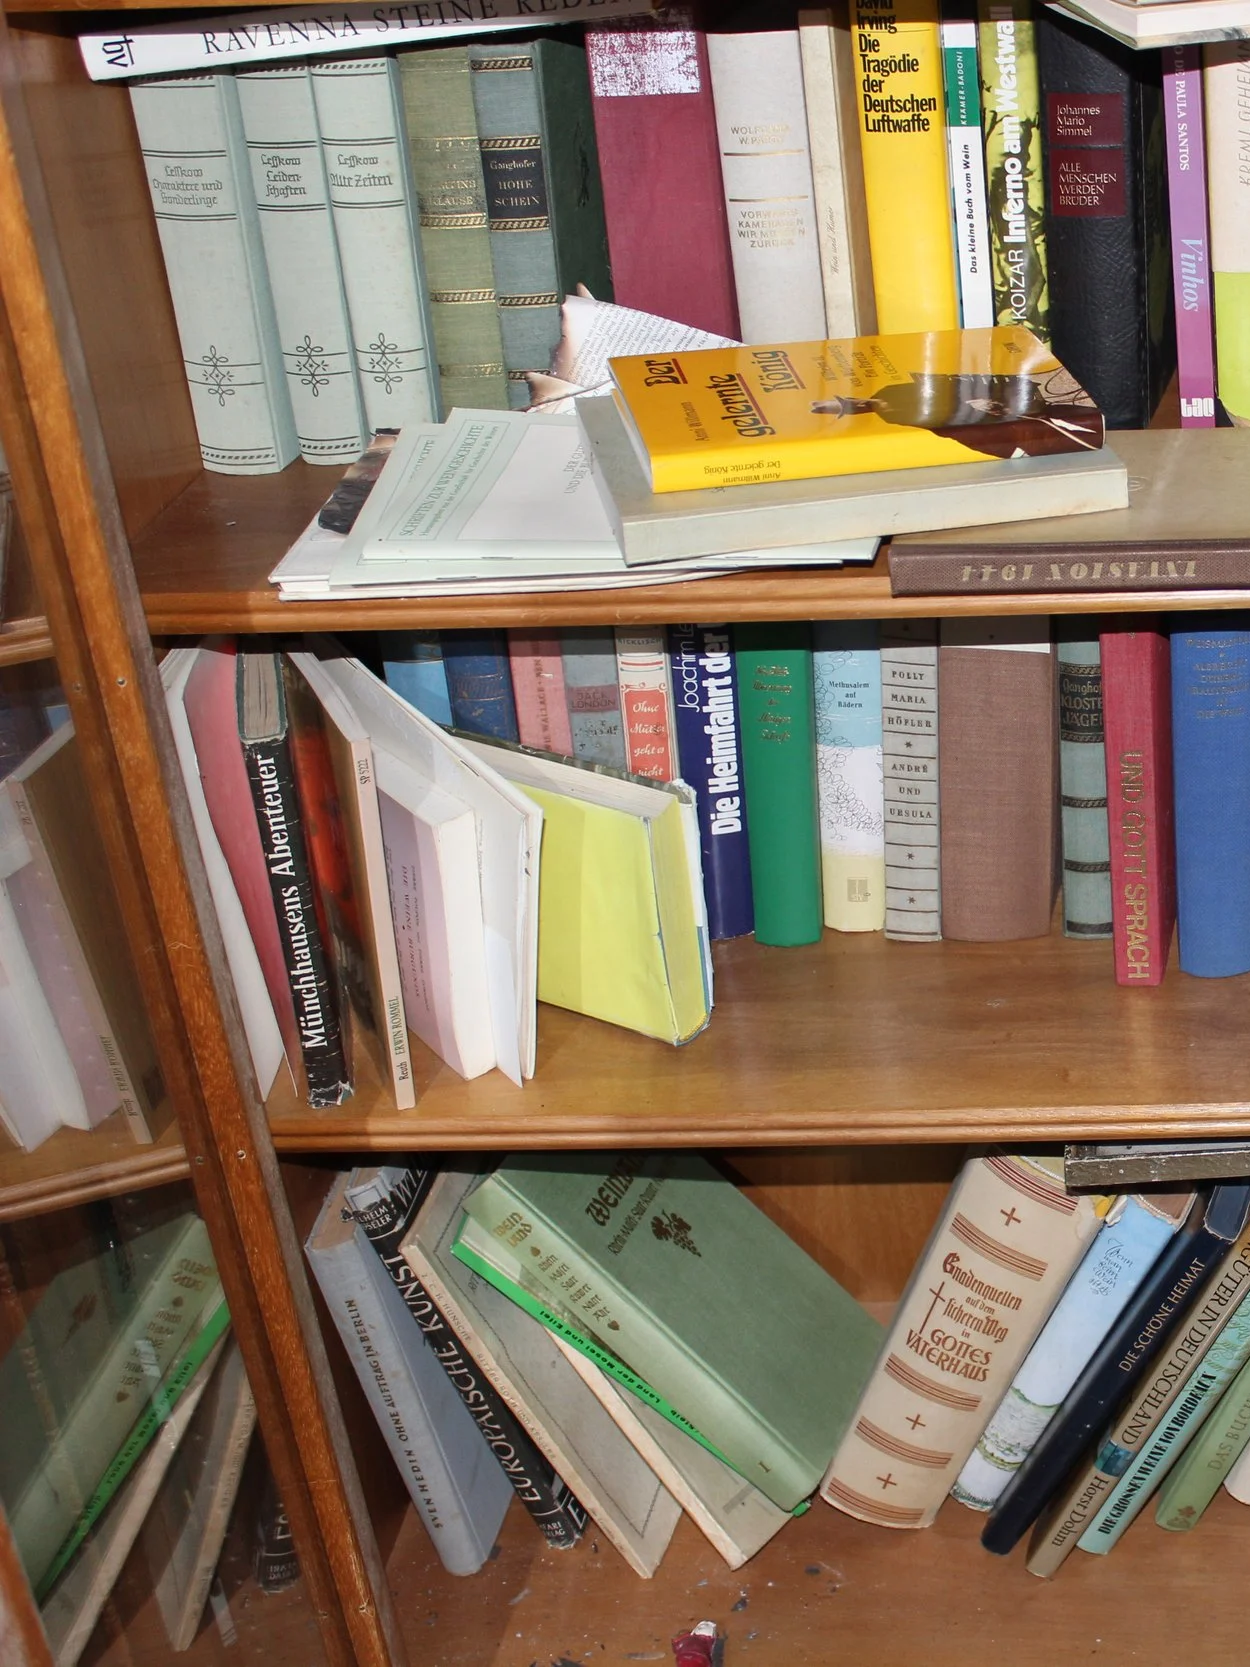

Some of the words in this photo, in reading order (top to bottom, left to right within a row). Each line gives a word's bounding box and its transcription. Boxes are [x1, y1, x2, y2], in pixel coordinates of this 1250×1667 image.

[857, 12, 897, 33] Irving
[859, 33, 880, 53] Die
[860, 54, 919, 77] Tragödie
[862, 76, 883, 93] der
[863, 94, 937, 113] Deutschen
[1056, 104, 1101, 117] Johannes
[864, 113, 930, 133] Luftwaffe
[1002, 115, 1021, 154] am
[1056, 116, 1085, 127] Mario
[1056, 126, 1092, 137] Simmel
[962, 144, 971, 169] Wein
[1059, 163, 1081, 173] ALLE
[964, 172, 973, 192] vom
[1059, 173, 1117, 184] MENSCHEN
[1059, 184, 1105, 195] WERDEN
[966, 197, 975, 220] Buch
[1003, 156, 1026, 243] Inferno
[1059, 195, 1100, 206] BRÜDER
[968, 222, 977, 250] kleine
[970, 253, 978, 273] Das
[1181, 238, 1205, 312] Vinhos
[1007, 249, 1026, 321] KOIZAR
[644, 360, 680, 387] Der
[752, 350, 799, 394] König
[705, 373, 776, 438] gelernte
[960, 562, 1034, 582] 1944
[1046, 559, 1198, 582] INVASION
[699, 634, 731, 673] der
[672, 640, 700, 712] Joachim
[829, 681, 870, 690] Methusalem
[891, 671, 925, 680] POLLY
[633, 702, 659, 714] Ohne
[837, 700, 863, 709] Rädern
[845, 691, 857, 699] auf
[891, 693, 927, 704] MARIA
[700, 675, 740, 793] Heimfahrt
[887, 716, 932, 728] HÖFLER
[891, 763, 929, 773] ANDRÉ
[1120, 750, 1145, 803] UND
[899, 787, 921, 796] UND
[258, 755, 295, 876] Abenteuer
[711, 796, 741, 836] Die
[889, 808, 933, 819] URSULA
[1121, 811, 1147, 877] GOTT
[1124, 884, 1150, 979] SPRACH
[283, 885, 328, 1049] Münchhausens
[381, 1252, 444, 1335] KUNST
[345, 1298, 371, 1343] BERLIN
[1118, 1349, 1141, 1373] DIE
[1133, 1301, 1173, 1353] SCHÖNE
[1170, 1257, 1206, 1308] HEIMAT
[364, 1344, 378, 1359] IN
[905, 1329, 990, 1383] VATERHAUS
[930, 1328, 993, 1366] GOTTES
[370, 1358, 400, 1414] AUFTRAG
[387, 1410, 409, 1442] OHNE
[432, 1340, 542, 1502] EUROPÄISCHE
[1207, 1441, 1233, 1472] DAS
[404, 1450, 429, 1491] HEDIN
[1084, 1475, 1110, 1502] Horst
[423, 1498, 443, 1529] SVEN
[1051, 1500, 1088, 1548] Dohm
